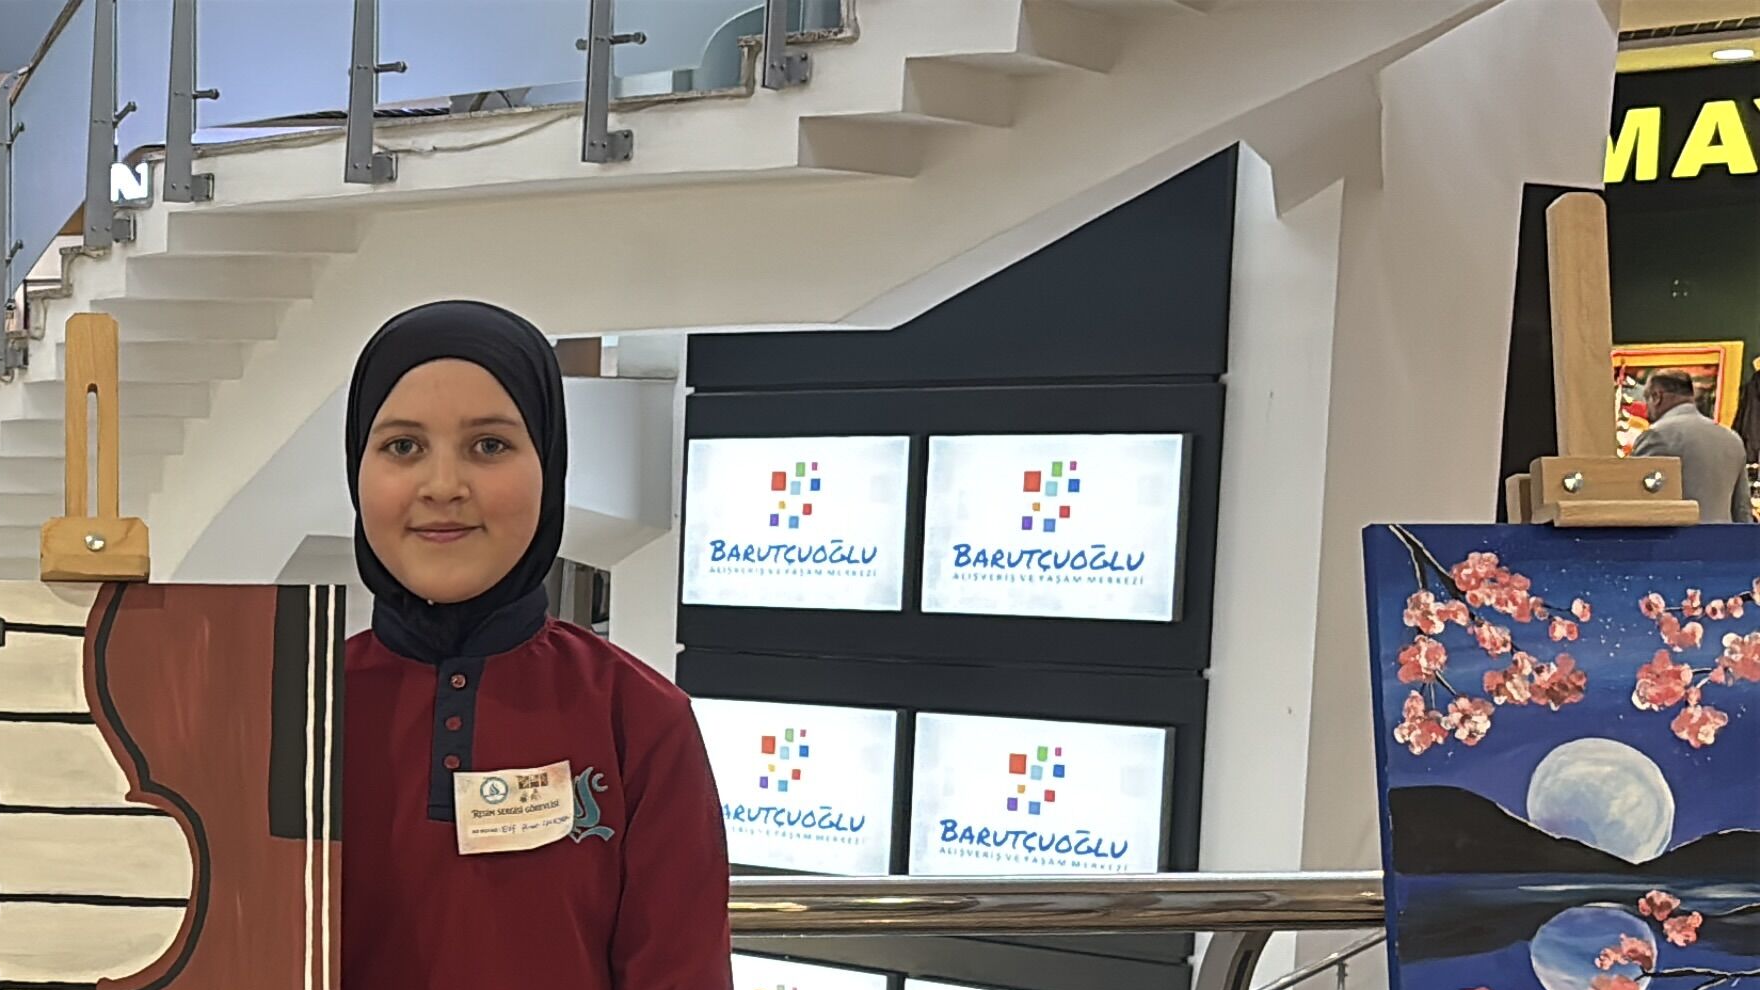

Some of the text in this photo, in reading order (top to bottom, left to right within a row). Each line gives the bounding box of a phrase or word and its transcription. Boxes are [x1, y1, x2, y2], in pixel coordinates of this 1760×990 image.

[1603, 99, 1760, 184] MA
[709, 539, 878, 566] BARUTÇUOĞLU
[953, 543, 1145, 572] BARUTÇUOĞLU
[723, 803, 866, 833] ARUTÇUOĞLU
[939, 818, 1129, 859] BARUTÇUOĞLU
